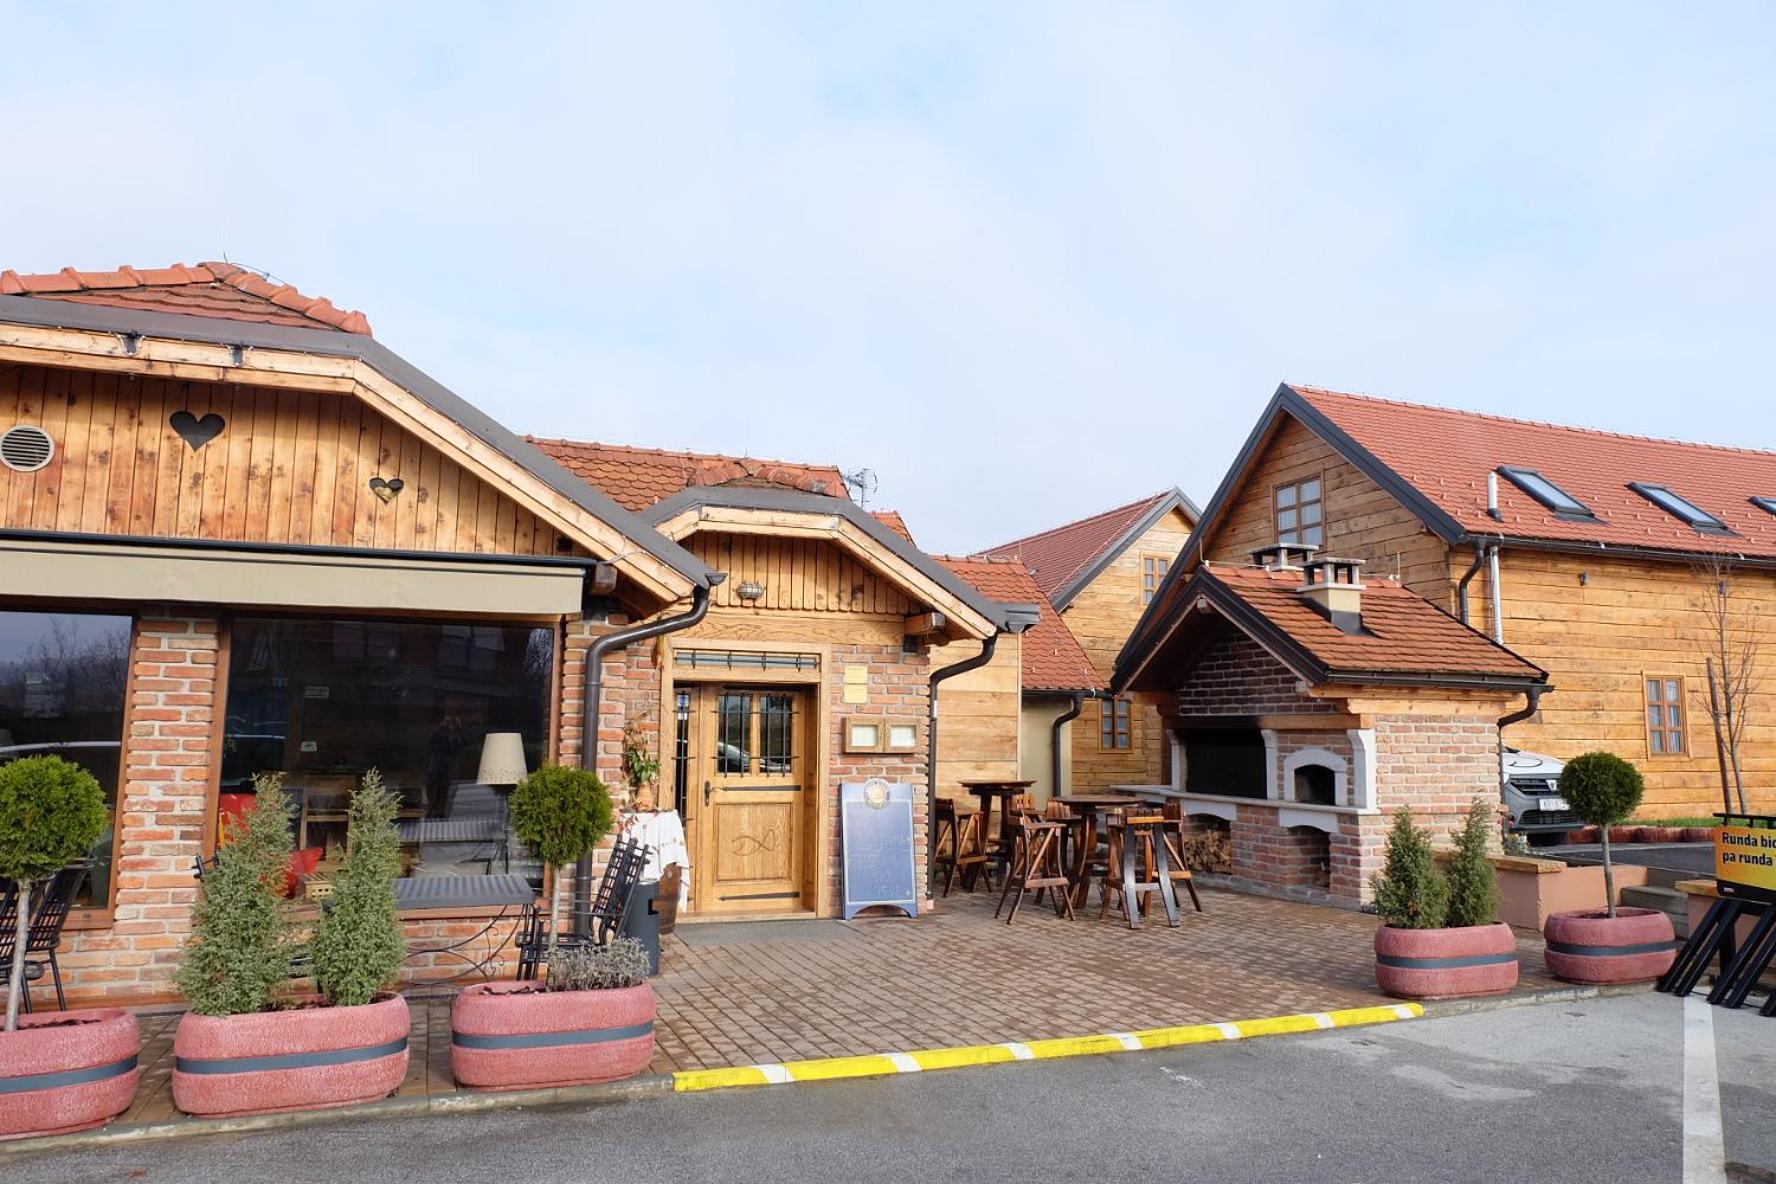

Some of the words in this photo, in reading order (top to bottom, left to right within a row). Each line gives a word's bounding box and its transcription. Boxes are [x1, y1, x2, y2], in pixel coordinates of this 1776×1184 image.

[1722, 832, 1757, 847] Runda
[1723, 852, 1736, 864] pa
[1739, 854, 1773, 866] runda
